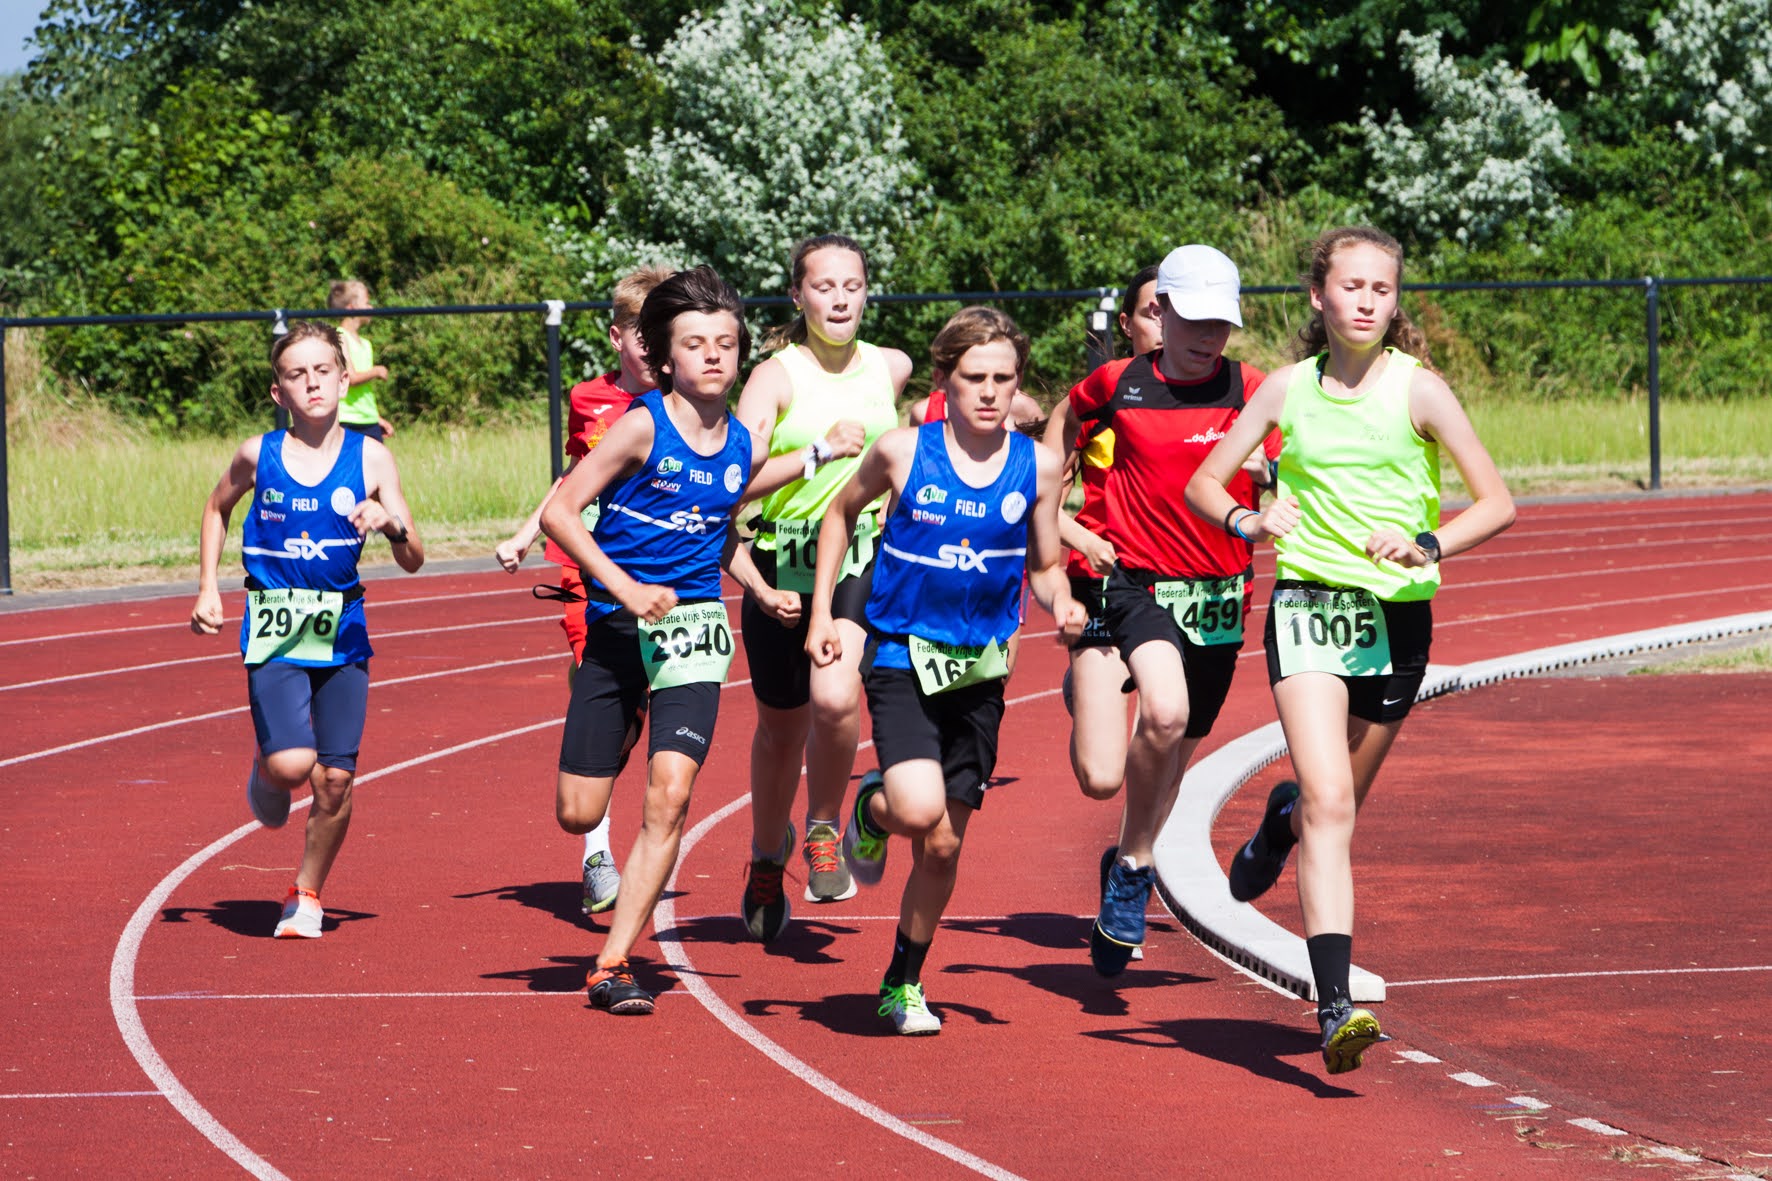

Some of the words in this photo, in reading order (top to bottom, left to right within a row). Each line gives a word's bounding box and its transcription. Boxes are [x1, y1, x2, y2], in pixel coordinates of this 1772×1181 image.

[783, 535, 860, 570] 101
[254, 595, 286, 605] Fderatie
[256, 607, 334, 639] 2976
[1285, 611, 1377, 650] 1005
[648, 623, 731, 664] 2040
